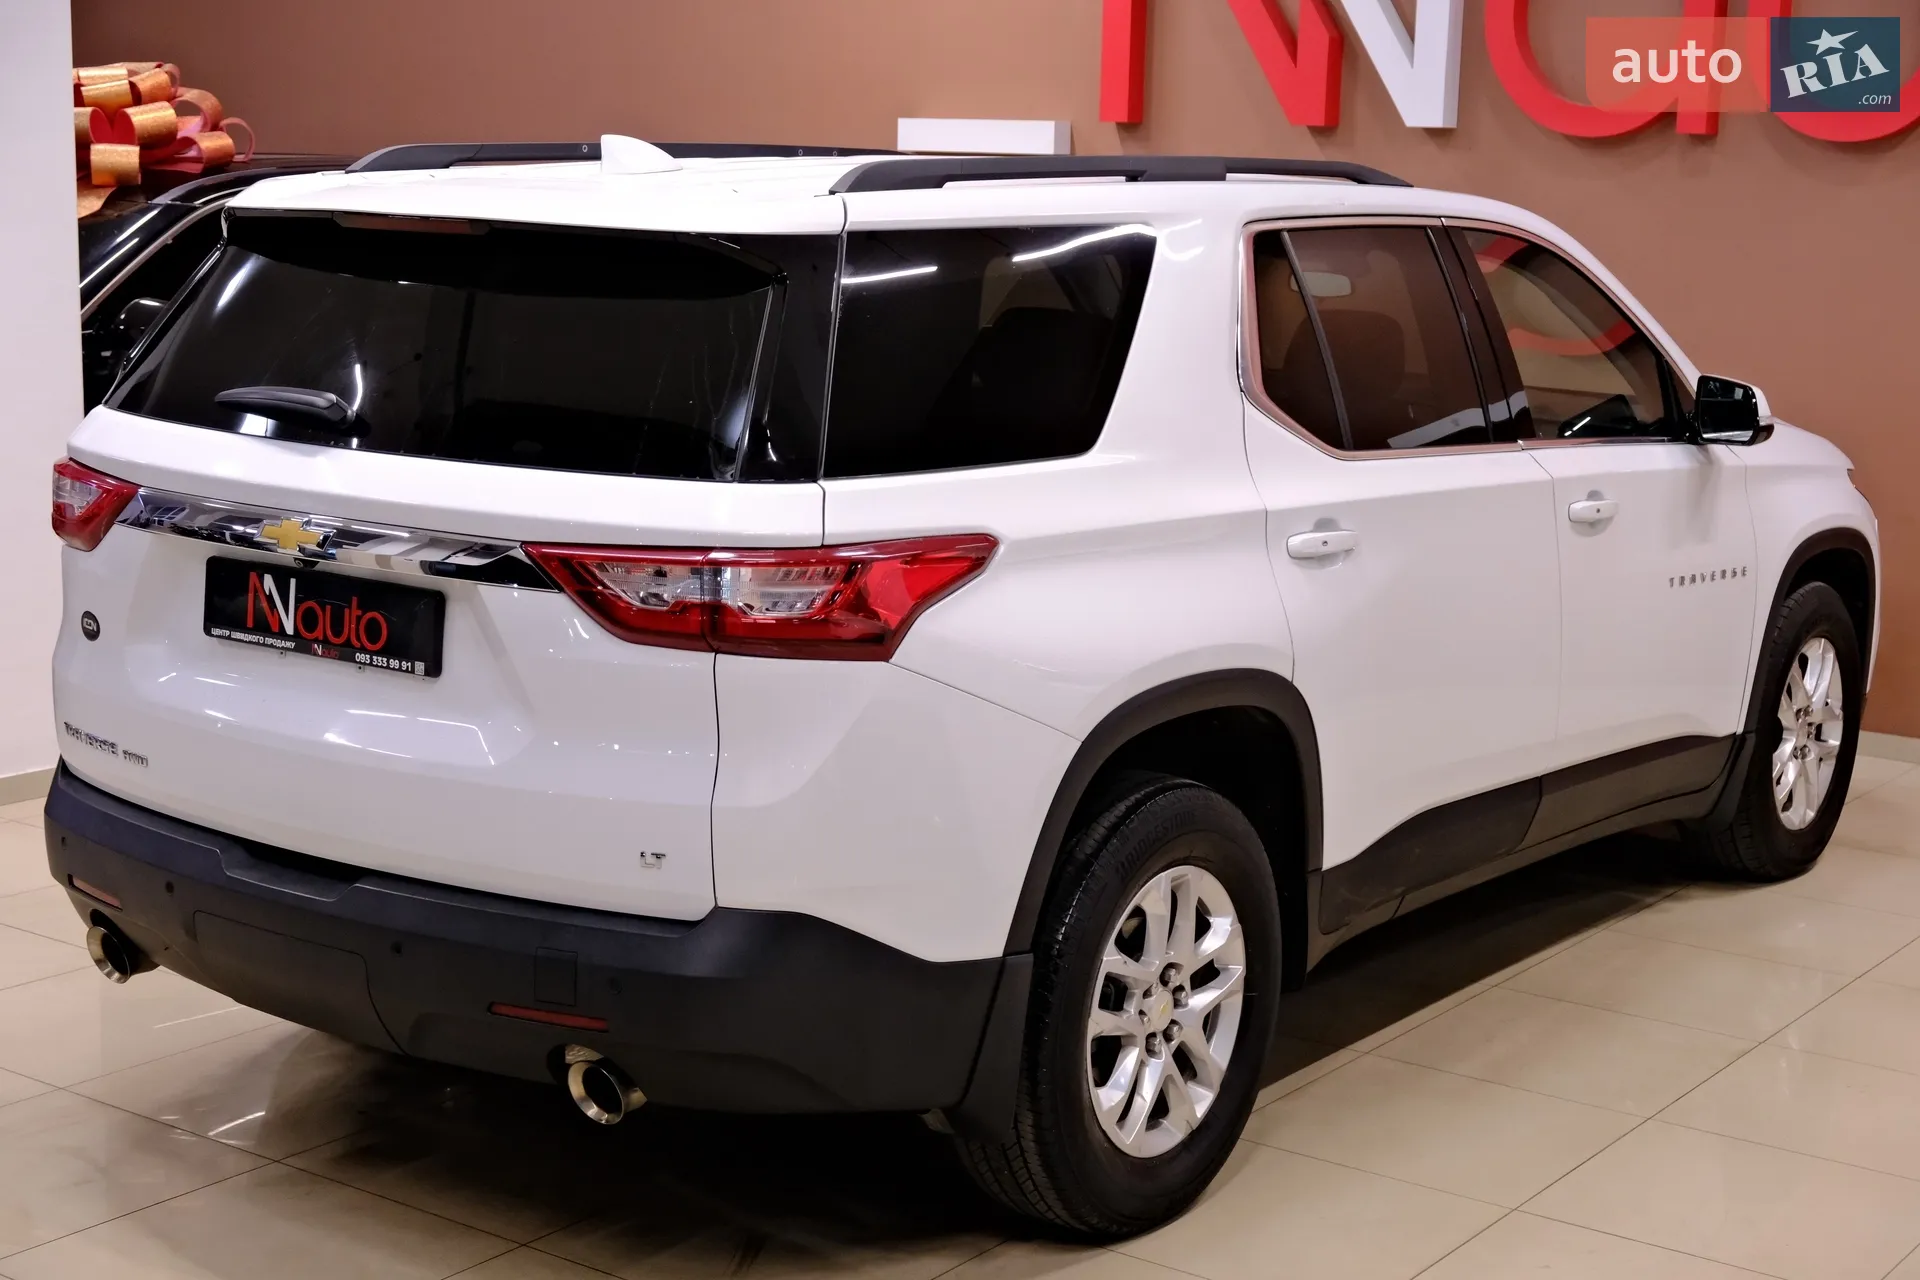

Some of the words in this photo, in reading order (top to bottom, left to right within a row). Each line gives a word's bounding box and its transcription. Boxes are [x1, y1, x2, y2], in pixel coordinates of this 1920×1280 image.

[1669, 566, 1747, 588] TRAVERSE
[211, 627, 230, 637] ЦЕНТР
[230, 631, 264, 644] ШВИДКОГО
[264, 637, 296, 649] ПРОДАЖУ
[355, 652, 370, 664] 093
[372, 655, 387, 667] 333
[389, 659, 400, 669] 99
[401, 661, 412, 671] 91
[640, 851, 666, 870] LT
